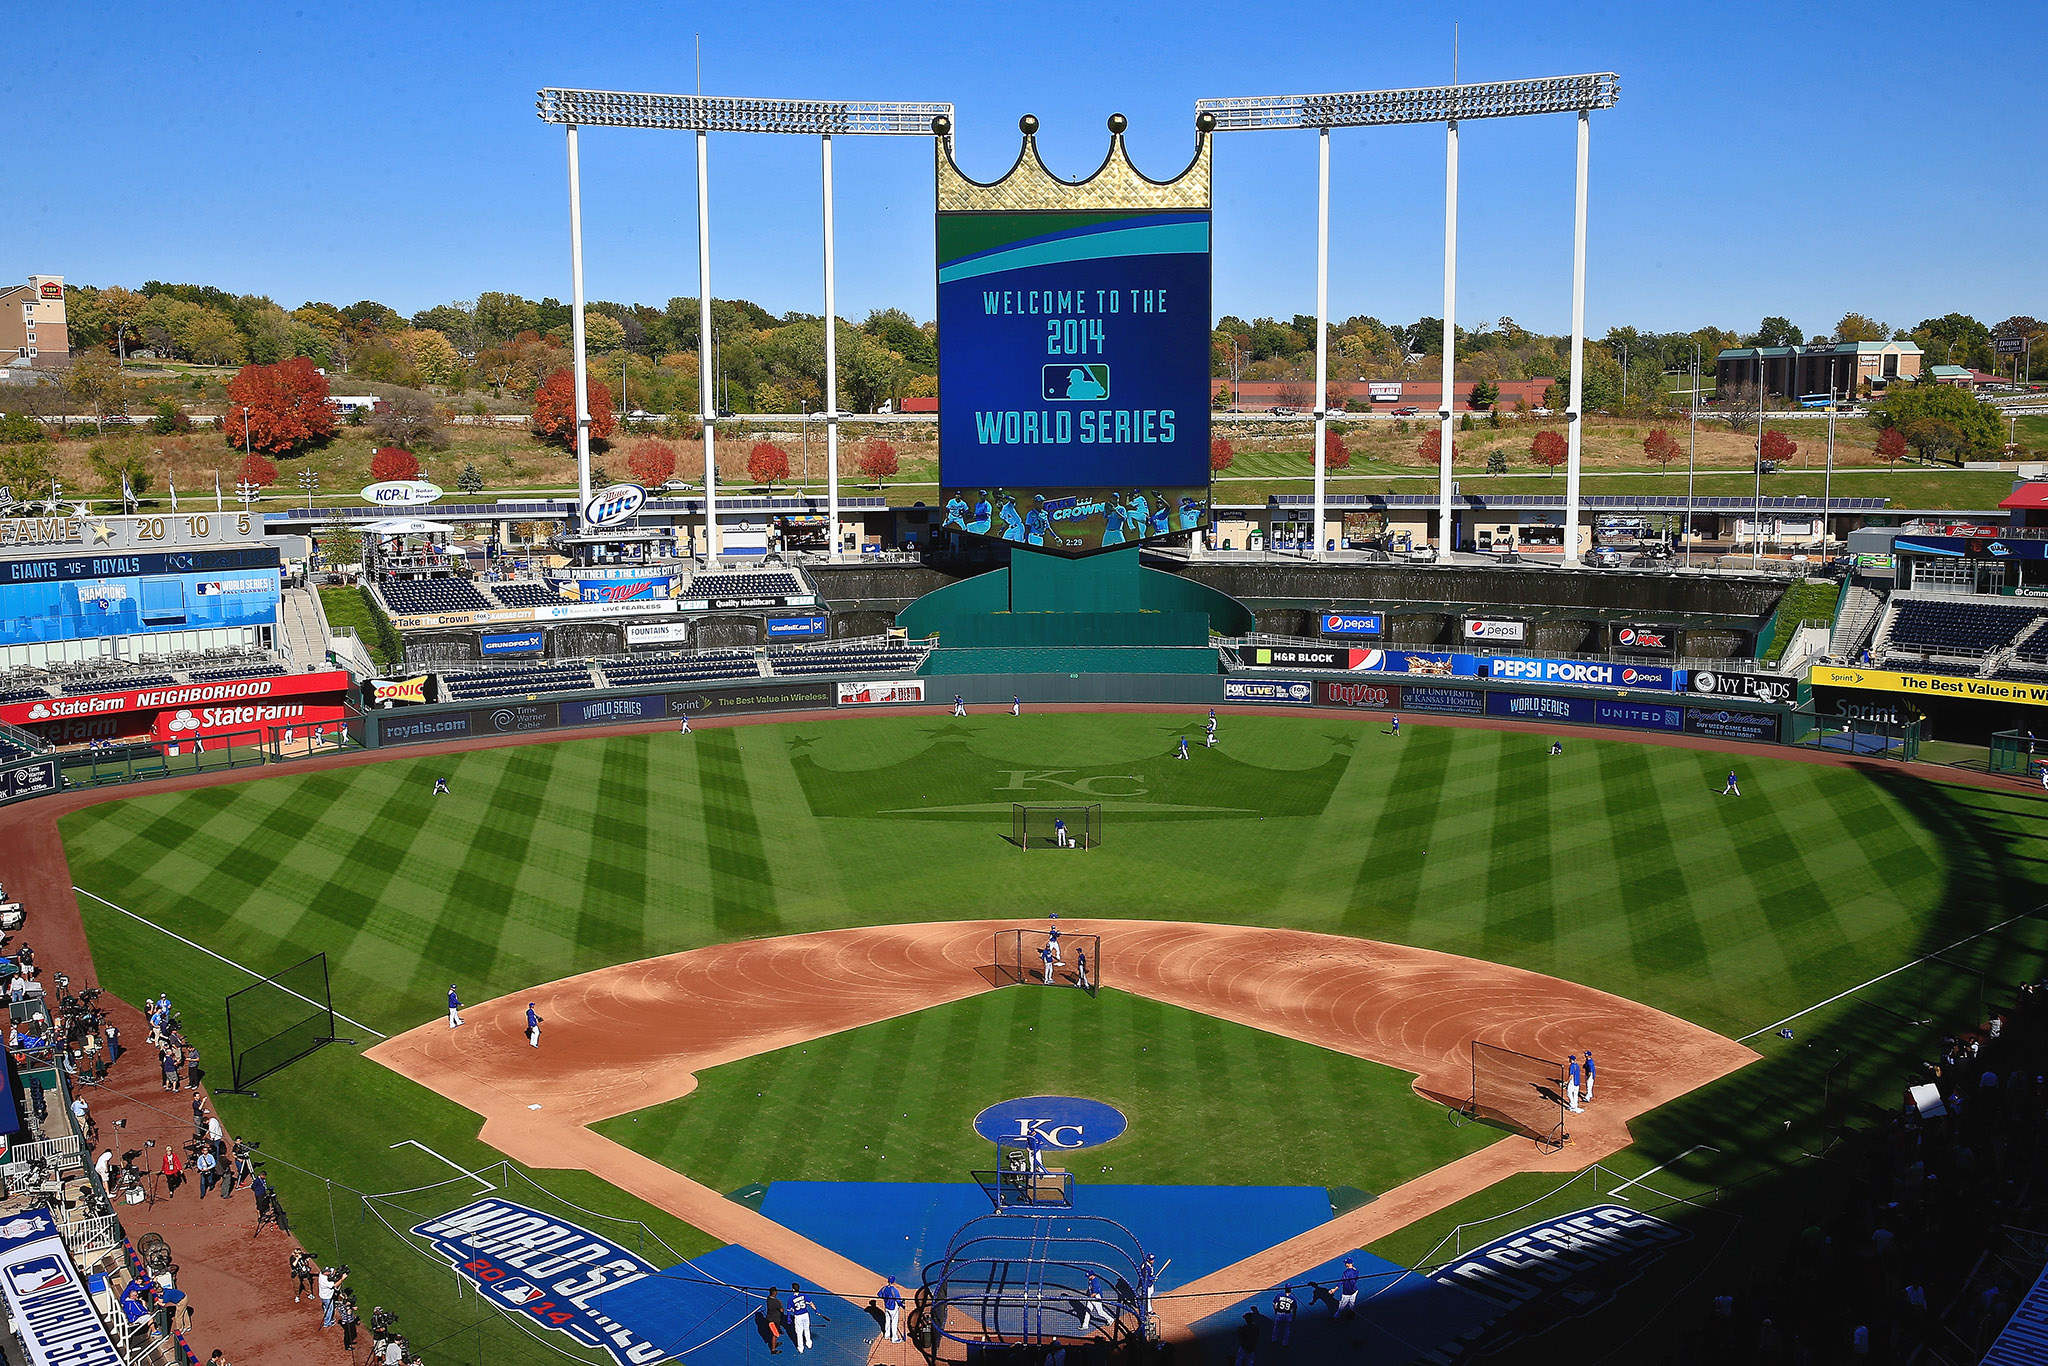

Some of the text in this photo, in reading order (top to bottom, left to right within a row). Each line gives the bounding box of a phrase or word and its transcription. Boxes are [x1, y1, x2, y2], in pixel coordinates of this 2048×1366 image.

[984, 289, 1167, 314] WELCOME TO THE
[1048, 319, 1105, 354] 2014
[976, 410, 1176, 444] WORLD SERIES
[376, 489, 410, 500] KCP&L
[603, 490, 630, 501] Miller
[596, 495, 638, 524] Lite
[1053, 502, 1105, 520] CROWN
[0, 518, 82, 540] FAME
[137, 513, 250, 540] 20 10 5
[1066, 538, 1082, 546] 2:29
[12, 558, 140, 579] GIANTS -VS- ROYALS
[552, 568, 570, 578] PROUD
[572, 569, 604, 578] PARTNER
[607, 570, 616, 578] OF
[618, 569, 633, 578] THE
[635, 568, 662, 578] KANSAS
[662, 566, 672, 576] CITY
[222, 578, 268, 590] WORLD SERIES
[584, 581, 668, 600] IT'S Miller TIME
[78, 586, 127, 602] CHAMPIONS
[716, 600, 740, 609] Quality
[742, 598, 776, 608] Healthcare
[391, 616, 470, 628] #TakeTheCrown
[490, 612, 517, 620] KANSAS
[1344, 619, 1375, 630] pepsi
[632, 627, 669, 636] FOUNTAINS
[1488, 626, 1517, 636] pepsi
[486, 640, 530, 650] GRUNDFOS
[1274, 652, 1332, 662] H&R BLOCK
[1493, 660, 1612, 683] PEPSI PORCH
[1638, 674, 1662, 682] pepsi
[377, 683, 424, 700] SONIC
[1227, 684, 1244, 692] FOX
[1246, 686, 1274, 694] LIVE
[1717, 674, 1740, 694] IVY
[1831, 672, 1854, 682] Sprint
[1901, 676, 1928, 688] The
[1931, 680, 1964, 692] Best
[1967, 682, 2010, 697] Value
[2012, 686, 2026, 698] in
[136, 681, 272, 708] NEIGHBORHOOD
[1415, 694, 1444, 704] KANSAS
[1446, 696, 1482, 706] HOSPITAL
[1428, 688, 1475, 698] UNIVERSITY
[672, 692, 828, 712] Sprint The Best Value in Wireless.
[1510, 699, 1570, 716] WORLD SERIES
[516, 713, 546, 722] Warner
[583, 701, 642, 720] WORLD SERIES
[1602, 708, 1661, 722] UNITED
[386, 719, 466, 738] royals.com
[517, 722, 541, 730] Cable
[994, 770, 1148, 796] KC
[1014, 1119, 1084, 1148] KC
[422, 1202, 610, 1279] WORLD
[464, 1259, 573, 1324] 20 14
[794, 1301, 806, 1310] 35
[1280, 1301, 1290, 1310] 59
[19, 1284, 102, 1346] WORLD
